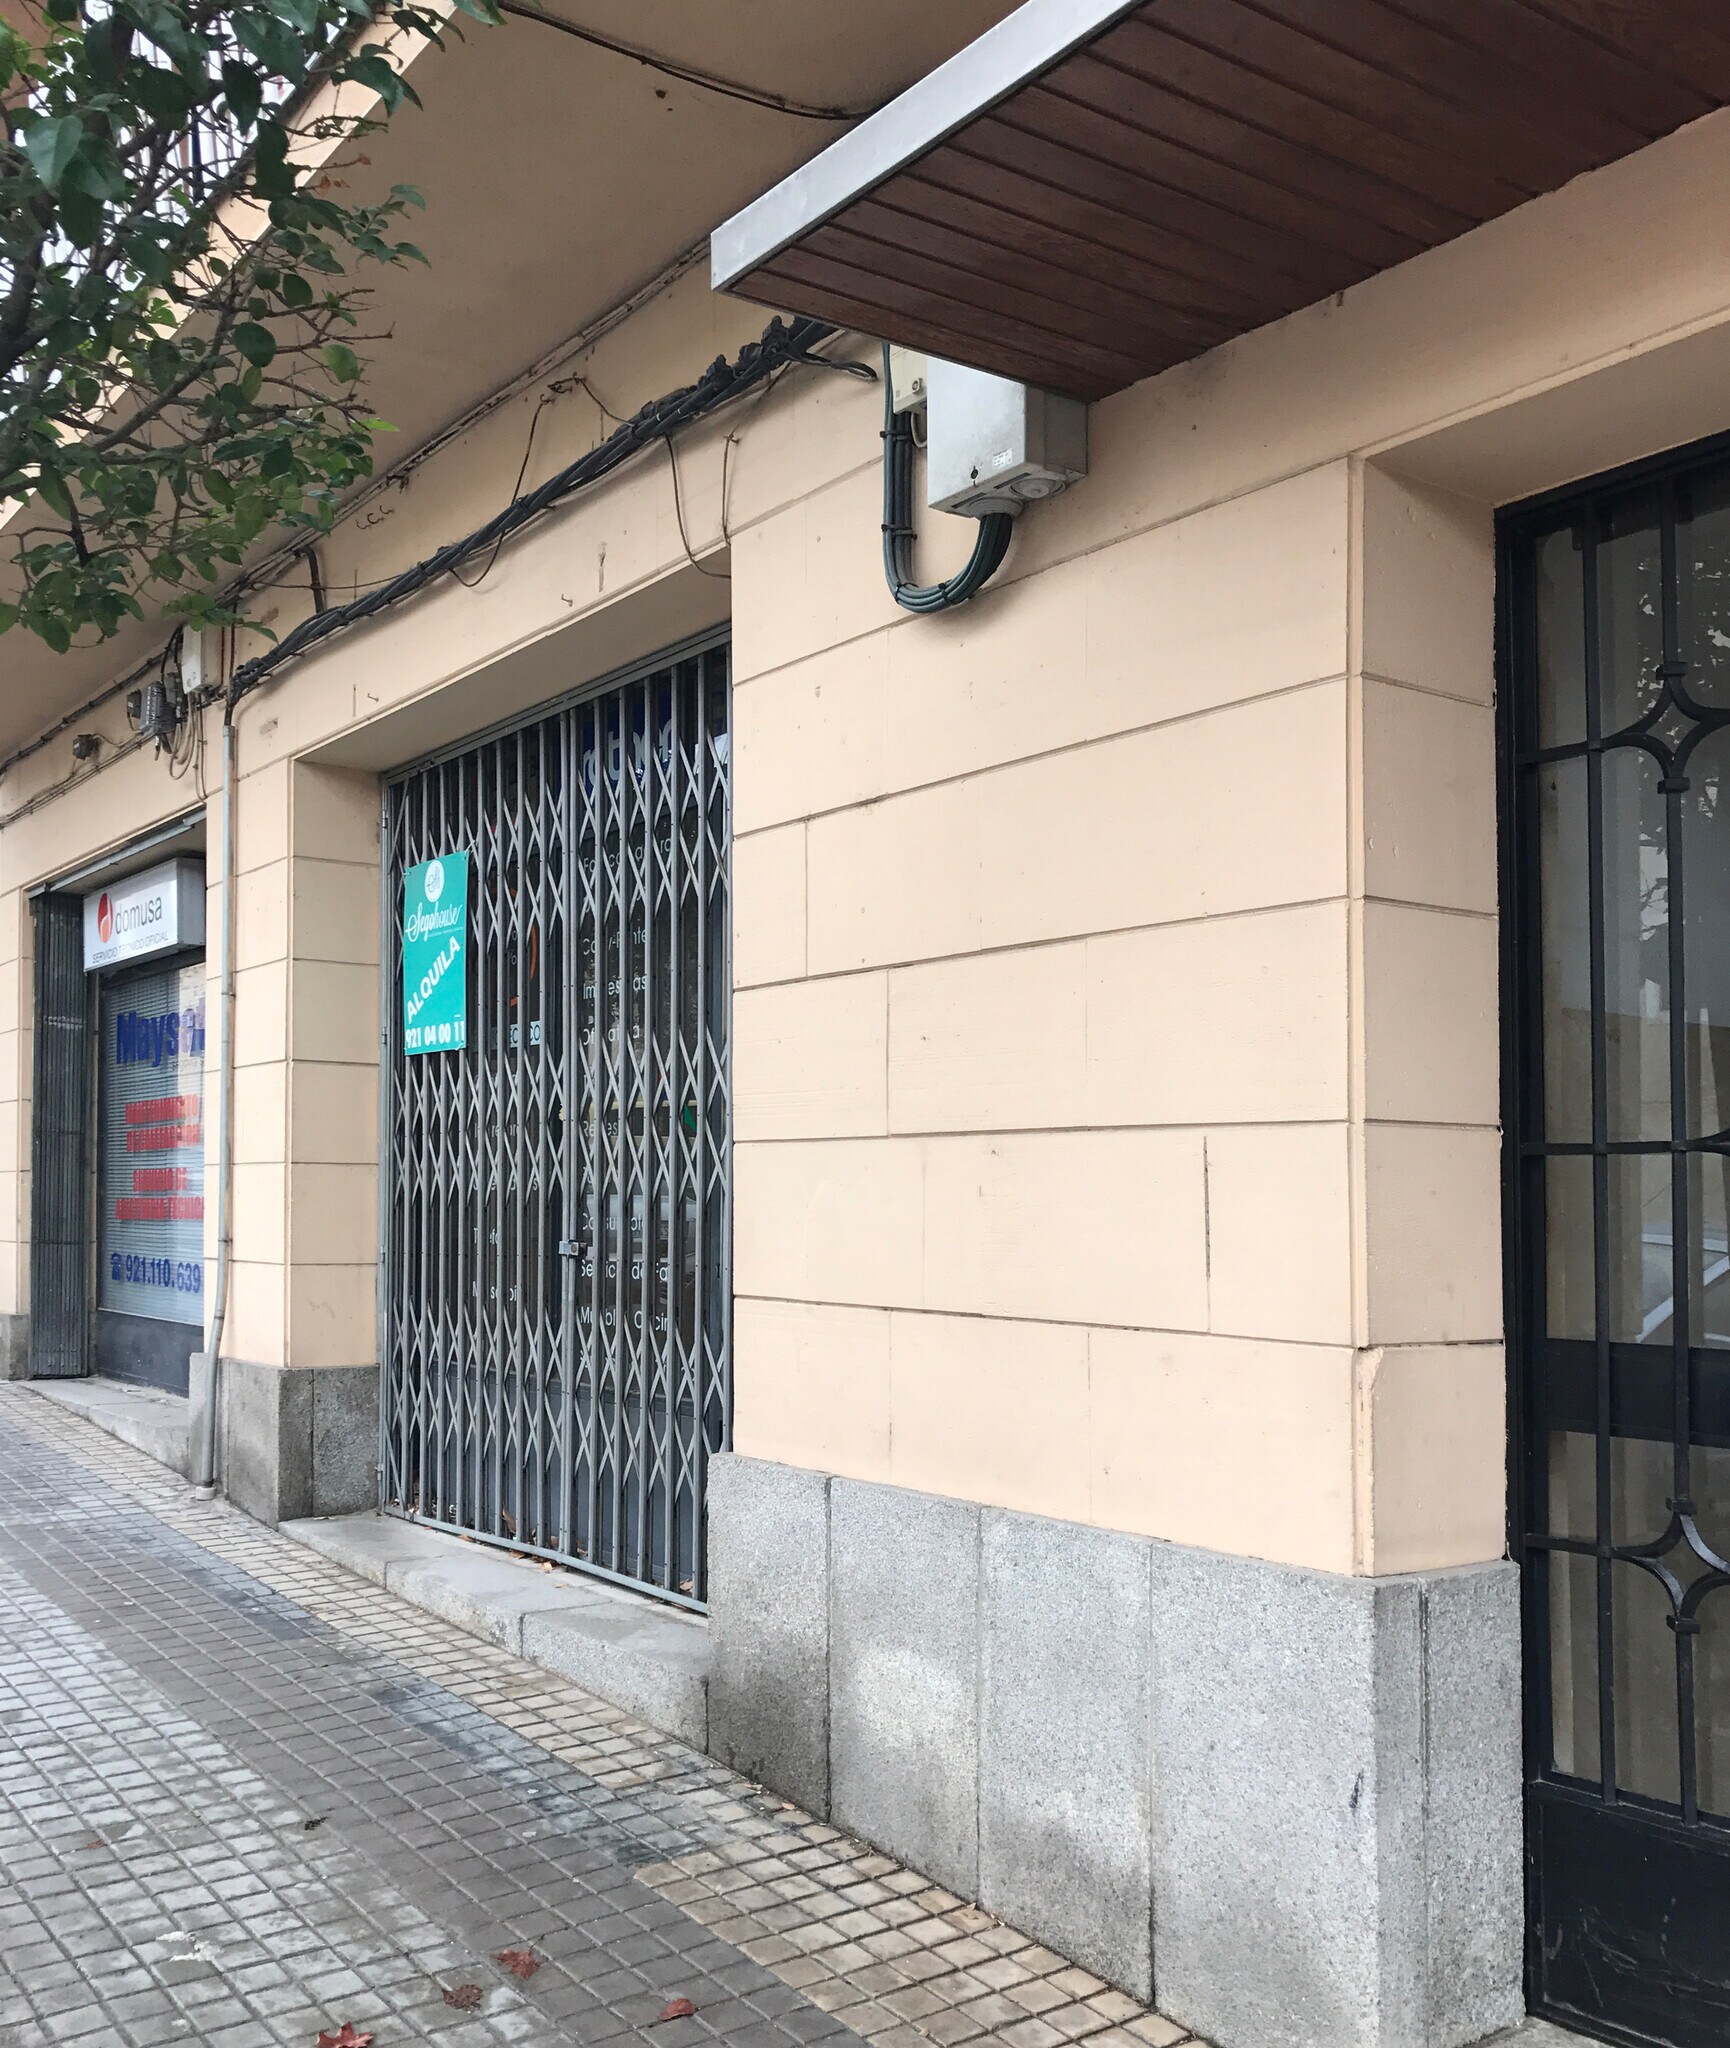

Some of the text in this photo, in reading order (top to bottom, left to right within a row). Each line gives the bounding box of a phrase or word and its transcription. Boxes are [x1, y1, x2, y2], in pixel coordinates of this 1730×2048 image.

[115, 896, 163, 935] domusa
[92, 947, 118, 964] SERVICIO
[145, 931, 169, 948] OFICIAL
[407, 936, 461, 1025] ALQUILA
[405, 1020, 465, 1049] 921 04 00 11
[126, 1254, 201, 1293] 921.110.639
